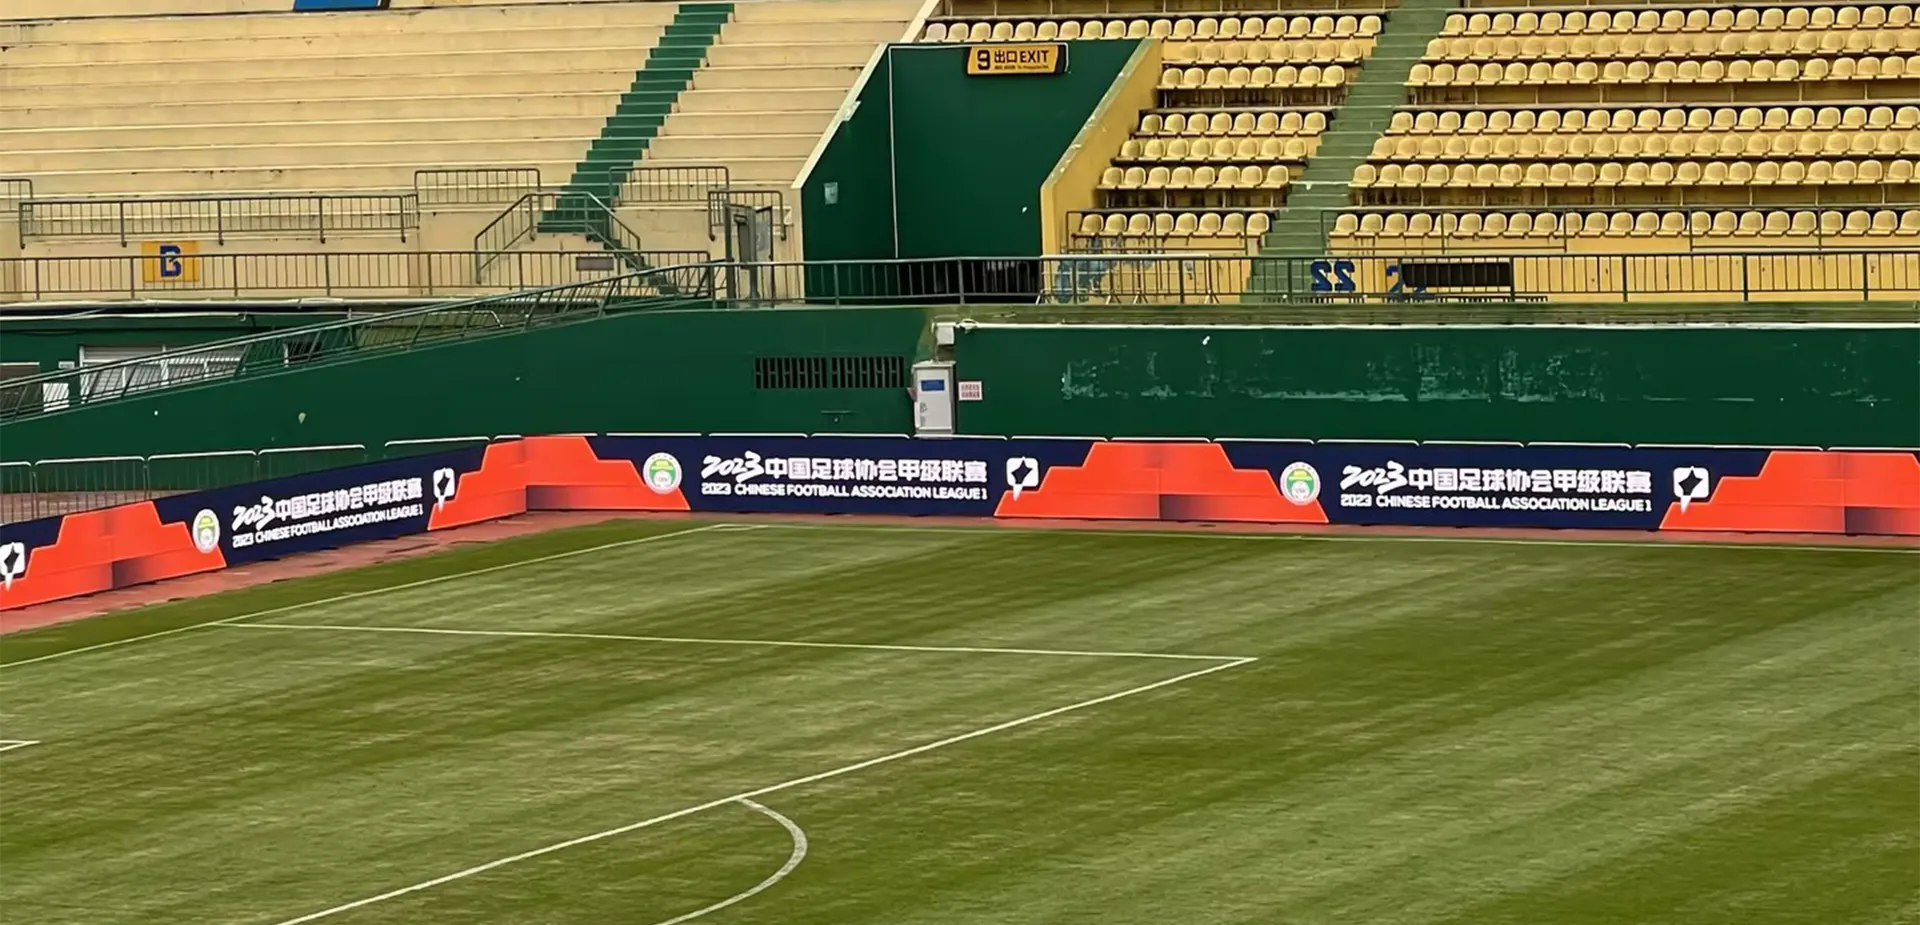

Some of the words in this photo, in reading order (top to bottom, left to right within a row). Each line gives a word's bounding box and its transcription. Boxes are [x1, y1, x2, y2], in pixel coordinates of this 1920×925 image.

[977, 49, 990, 70] 9
[1019, 50, 1049, 63] EXIT
[701, 482, 731, 495] 2023
[734, 483, 786, 496] CHINESE
[786, 484, 850, 497] FOOTBALL
[851, 485, 931, 498] ASSOCIATION
[933, 487, 980, 499] LEAGUE
[1340, 494, 1372, 507] 2023
[1375, 495, 1431, 508] CHINESE
[1432, 496, 1500, 509] FOOTBALL
[1502, 497, 1590, 510] ASSOCIATION
[1591, 498, 1644, 511] LEAGUE
[232, 532, 254, 548] 2023
[255, 525, 290, 544] CHINESE
[290, 519, 332, 537] FOOTBALL
[332, 508, 386, 529] ASSOCIATION
[386, 504, 419, 521] LEAGUE
